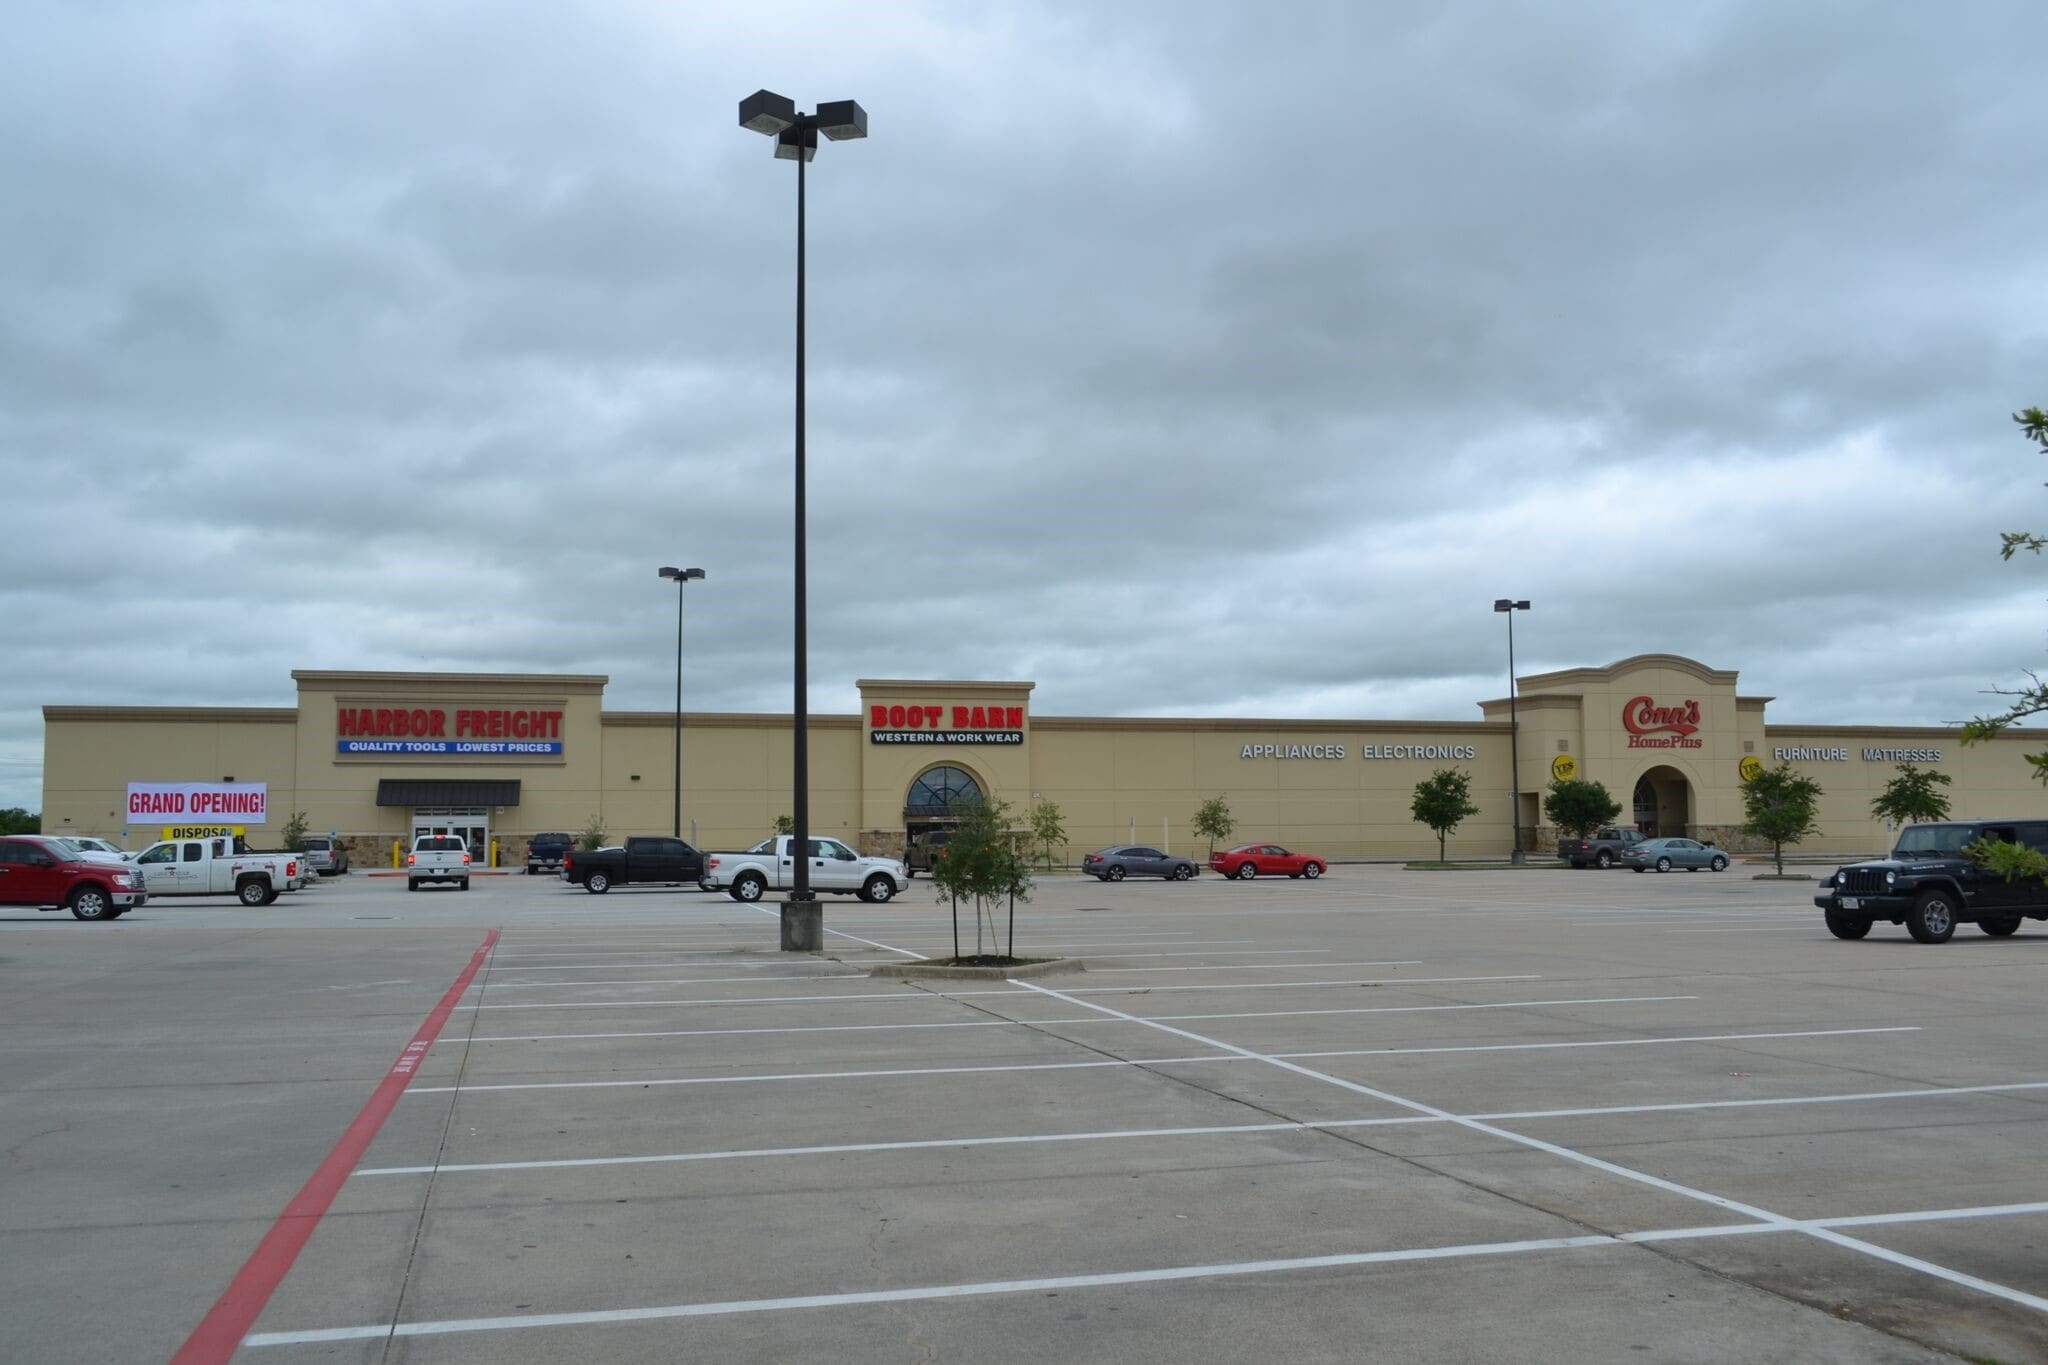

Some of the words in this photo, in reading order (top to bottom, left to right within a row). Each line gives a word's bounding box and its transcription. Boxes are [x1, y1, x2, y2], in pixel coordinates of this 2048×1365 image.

[338, 709, 446, 737] HARBOR
[456, 710, 563, 737] FREIGHT
[870, 705, 942, 728] BOOT
[952, 706, 1023, 728] BARN
[1623, 696, 1701, 736] Conn's
[875, 733, 934, 742] WESTERN
[936, 733, 944, 742] &
[946, 733, 982, 742] WORK
[985, 734, 1020, 742] WEAR
[1628, 736, 1702, 748] HomePlus
[349, 742, 402, 751] QUALITY
[406, 742, 446, 751] TOOLS
[456, 743, 505, 752] LOWEST
[508, 743, 552, 752] PRICES
[1241, 745, 1345, 758] APPLIANCES
[1363, 745, 1475, 759] ELECTRONICS
[1774, 747, 1848, 760] FURNITURE
[1862, 749, 1942, 761] MATTRESSES
[1555, 761, 1574, 773] YES
[129, 793, 184, 813] GRAND
[190, 793, 265, 813] OPENING!
[173, 827, 231, 839] DISPOSA
